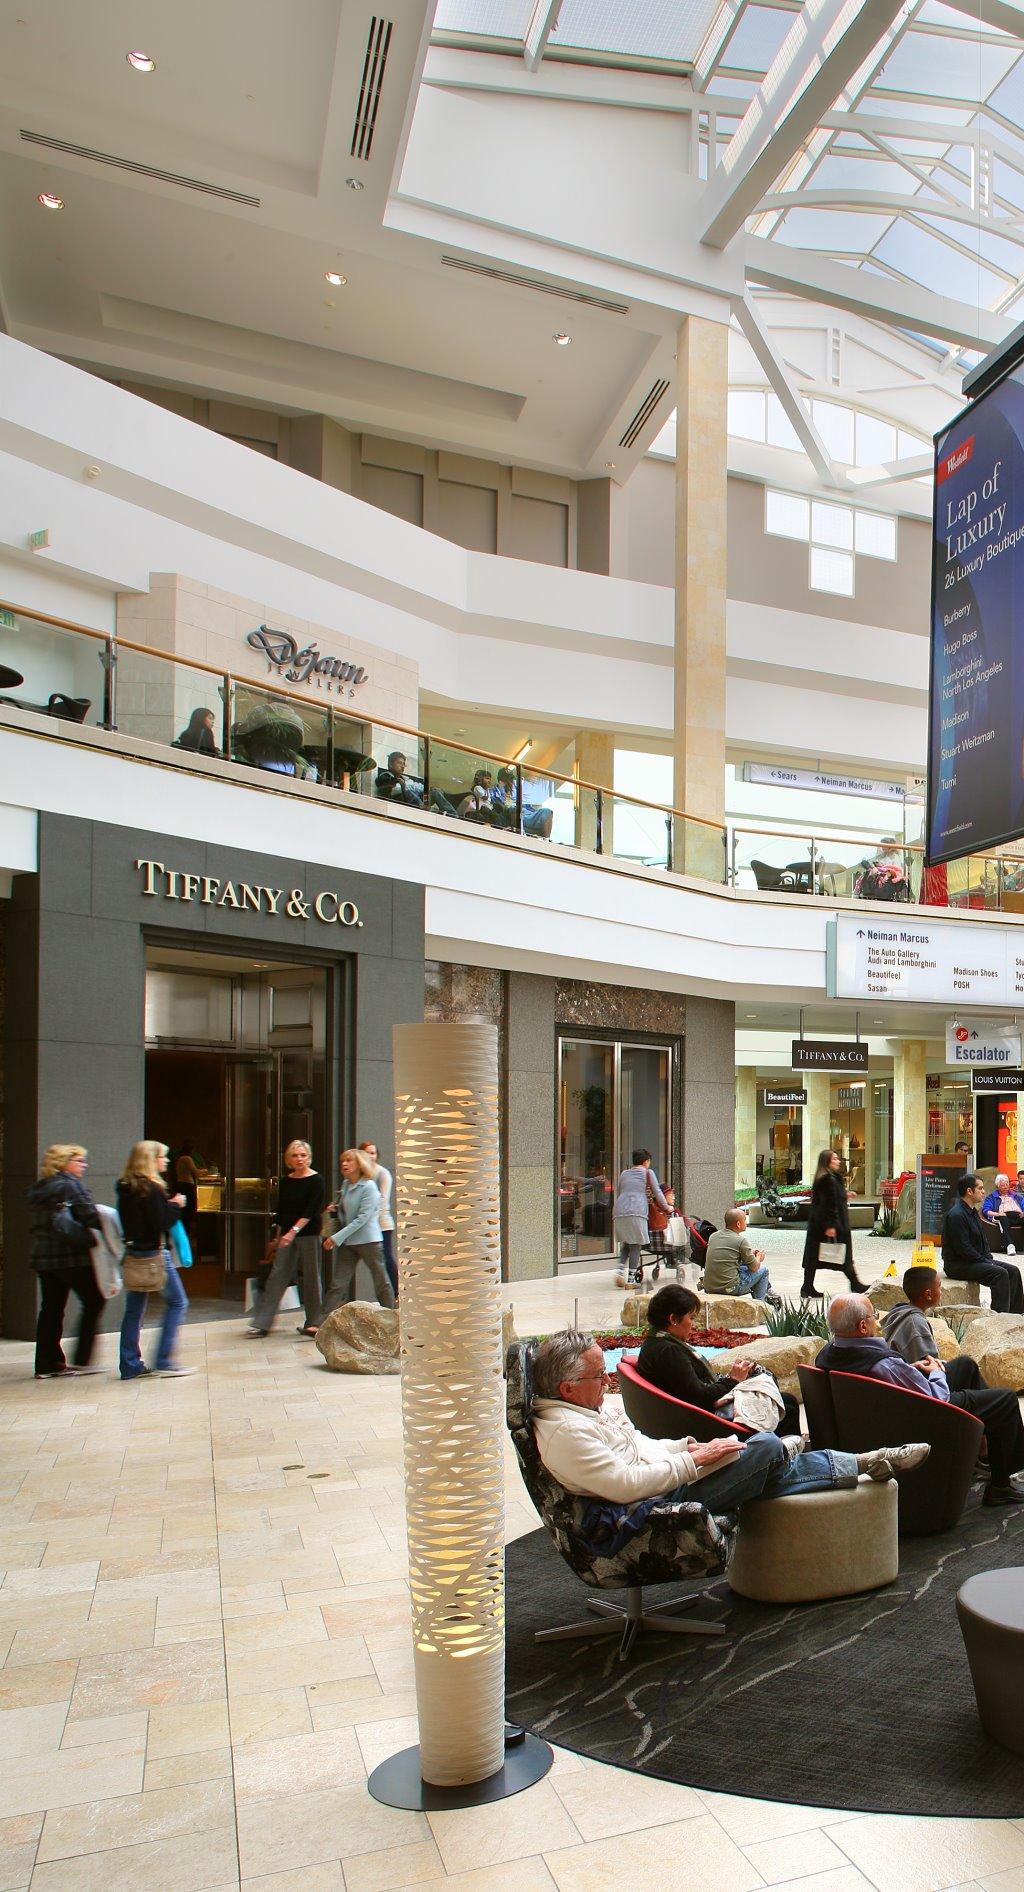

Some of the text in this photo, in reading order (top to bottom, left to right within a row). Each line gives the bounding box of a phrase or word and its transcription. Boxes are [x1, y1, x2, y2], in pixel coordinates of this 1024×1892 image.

[947, 447, 969, 474] Westfield
[946, 462, 1002, 530] Lap of
[946, 502, 1006, 563] Luxury
[944, 572, 954, 590] 26
[957, 552, 984, 582] Luxury
[944, 604, 971, 626] Burberry
[944, 630, 977, 656] Hugo Boss
[268, 662, 356, 698] JEWELERS
[942, 655, 982, 686] Lamborghini
[942, 662, 1003, 700] North Los Angeles
[942, 710, 969, 730] Madison
[941, 730, 995, 760] Stuart Weitzman
[778, 770, 872, 791] Sears Neiman Marcus
[941, 774, 956, 790] Tumi
[135, 859, 284, 914] TIFFANY
[286, 888, 311, 919] &
[868, 930, 929, 944] Neiman Marcus
[868, 947, 920, 959] The Auto Gallery
[868, 956, 937, 968] Audi and Lamborghini
[868, 970, 901, 979] Beautifeel
[953, 967, 998, 978] Madison Shoes
[868, 984, 888, 992] Sasan
[953, 981, 970, 989] POSH
[798, 1049, 839, 1061] TIFFANY
[839, 1052, 847, 1061] &
[956, 1045, 1010, 1061] Escalator
